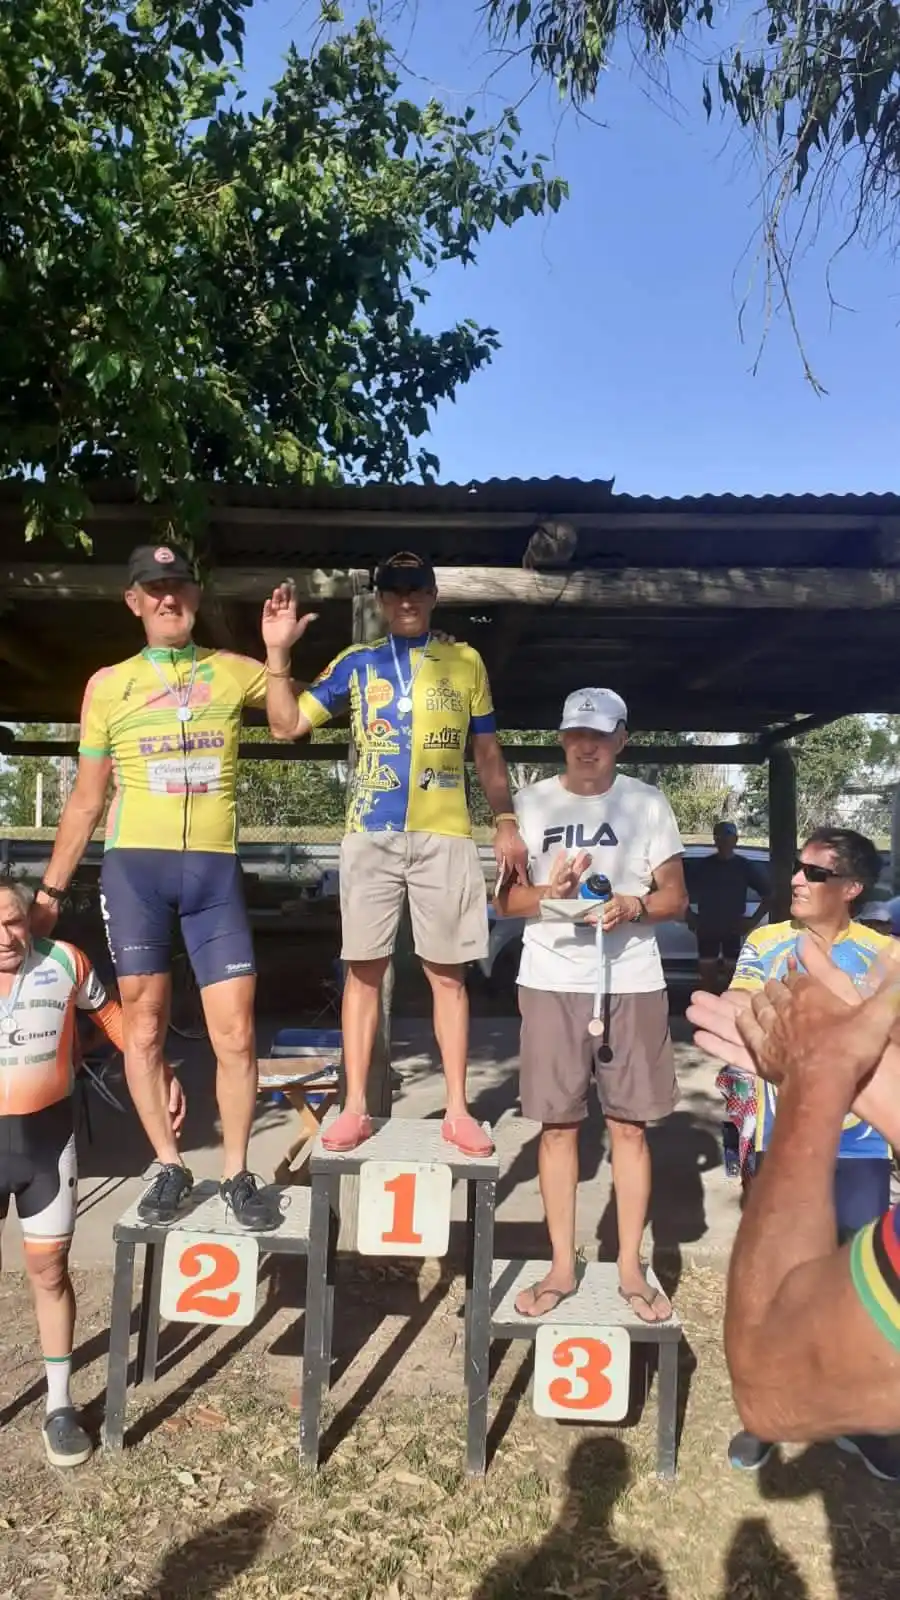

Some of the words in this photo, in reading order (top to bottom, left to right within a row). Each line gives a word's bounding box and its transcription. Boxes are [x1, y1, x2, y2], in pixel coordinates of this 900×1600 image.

[426, 688, 463, 699] OSCAR
[426, 698, 464, 712] BIKES
[542, 822, 619, 853] FILA
[381, 1173, 423, 1244] 1
[176, 1243, 240, 1317] 2
[549, 1337, 613, 1409] 3
